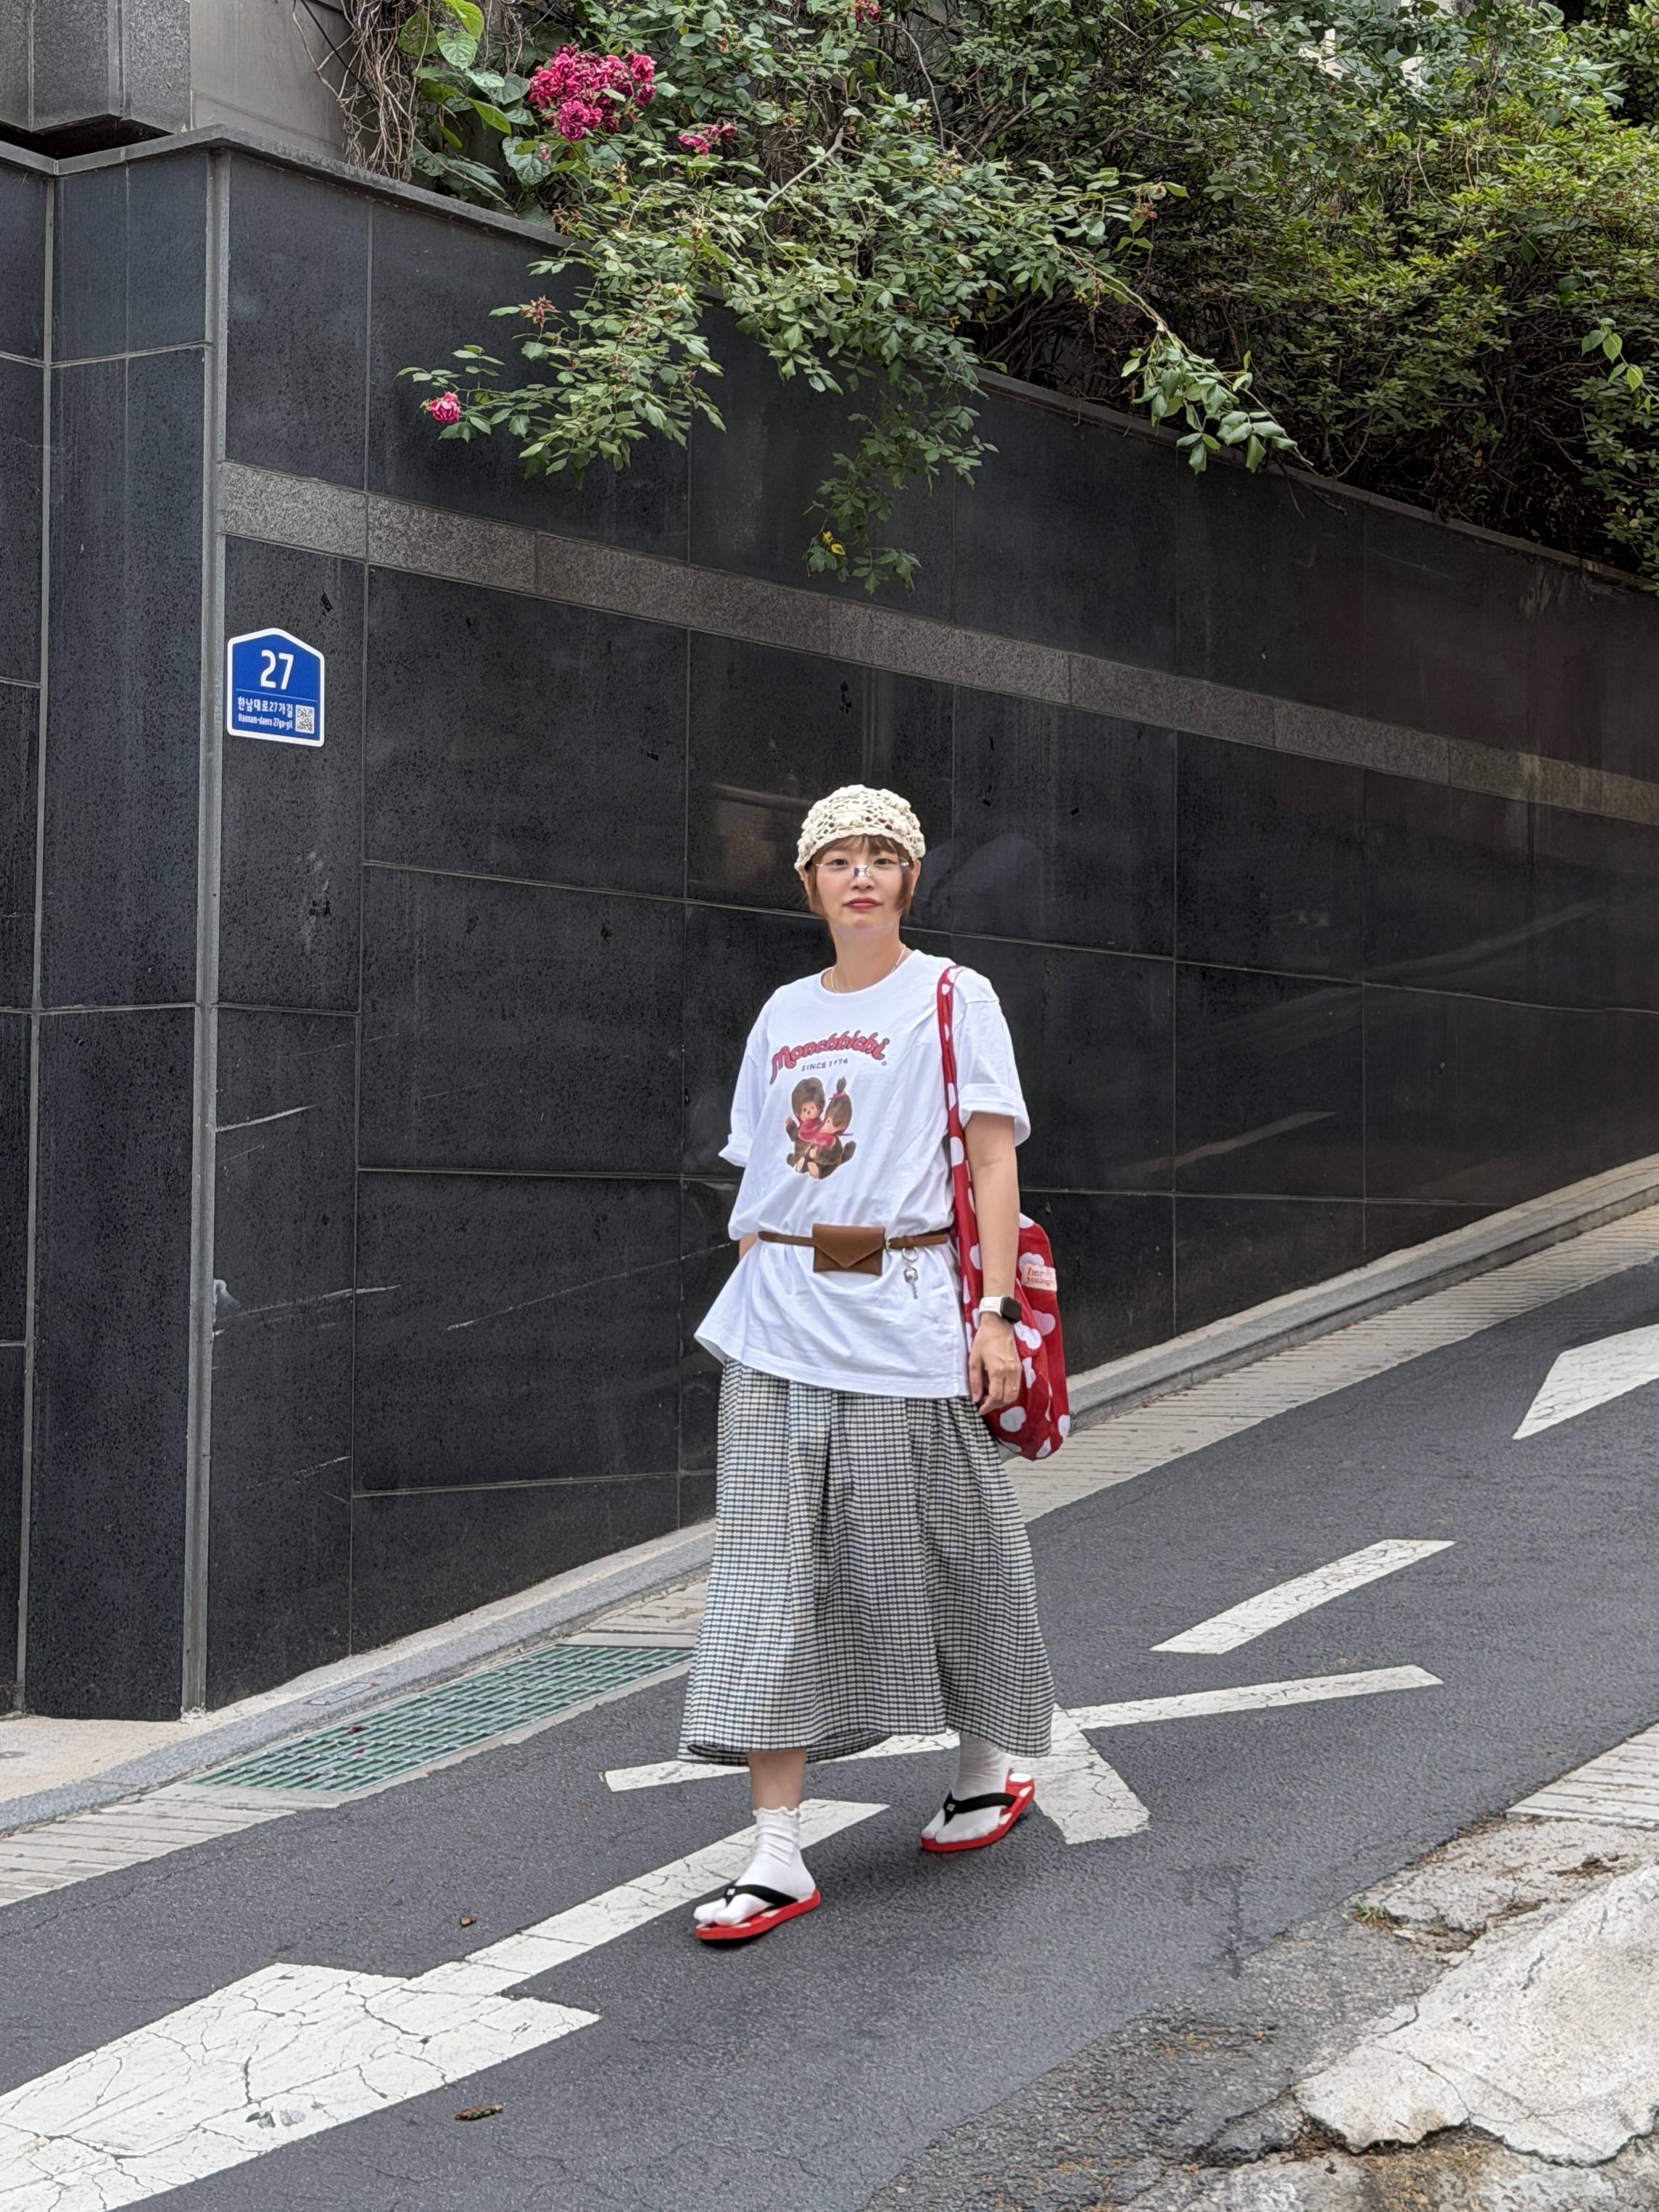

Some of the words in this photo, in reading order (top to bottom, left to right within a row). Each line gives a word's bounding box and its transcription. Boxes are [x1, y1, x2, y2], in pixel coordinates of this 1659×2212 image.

[260, 650, 294, 690] 27
[238, 696, 293, 718] 한남대로27가길
[800, 1061, 827, 1072] SINCE
